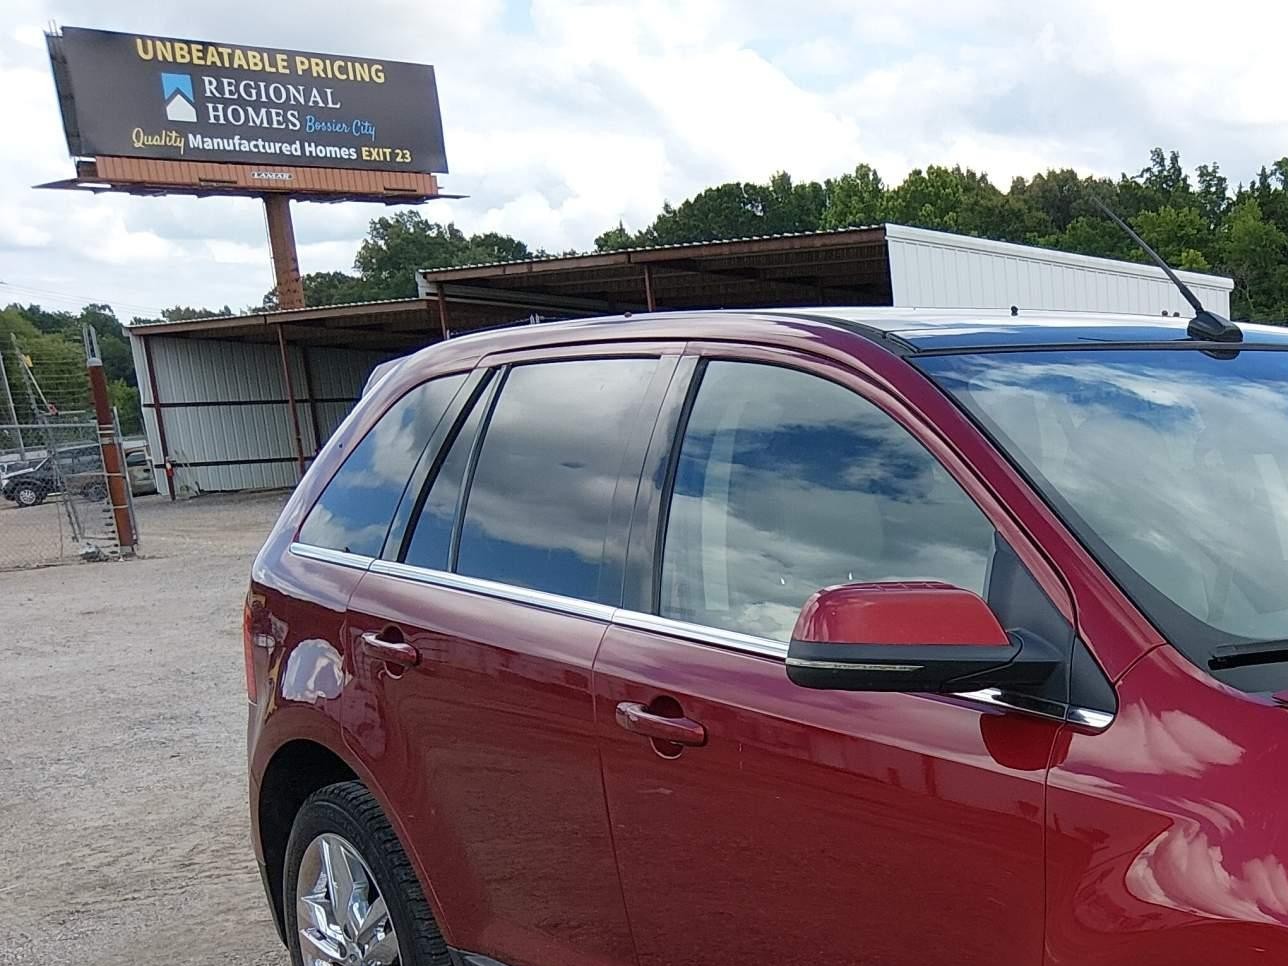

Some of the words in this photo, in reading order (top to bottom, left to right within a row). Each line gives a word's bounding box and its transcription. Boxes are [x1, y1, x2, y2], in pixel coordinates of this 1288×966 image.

[135, 38, 290, 75] UNBEATABLE
[295, 56, 385, 84] PRICING
[201, 76, 341, 109] REGIONAL
[206, 103, 301, 131] HOMES
[305, 115, 350, 134] Bossier
[352, 119, 376, 142] City
[132, 127, 185, 155] Quality
[188, 133, 301, 156] Manufactured
[304, 142, 358, 160] Homes
[361, 146, 392, 162] EXIT
[395, 149, 412, 163] 23
